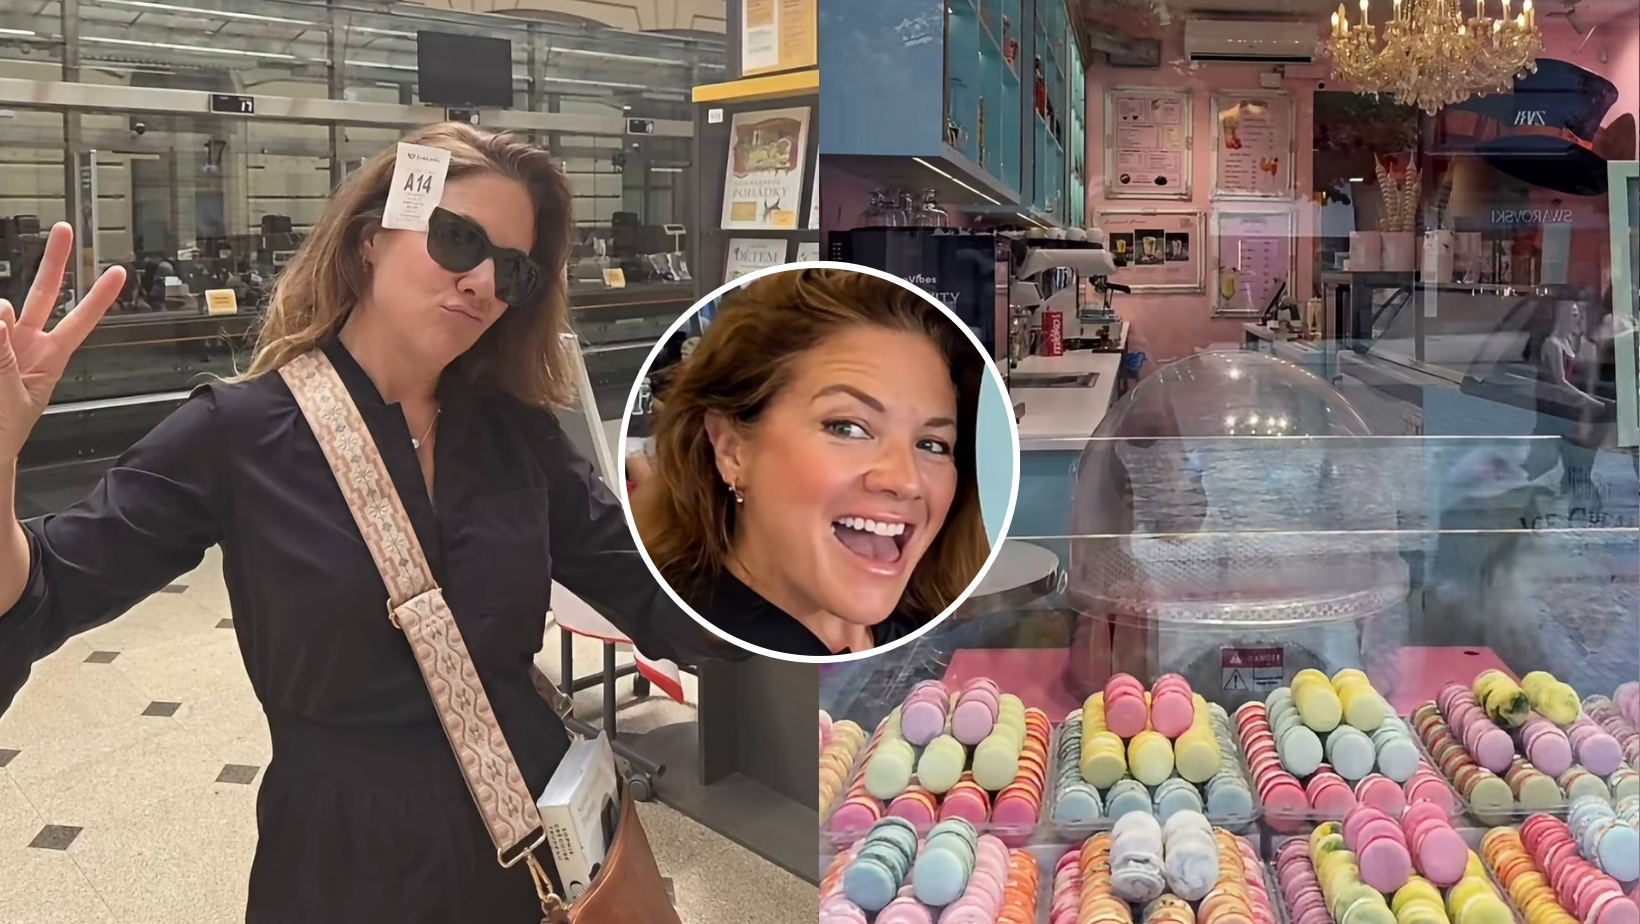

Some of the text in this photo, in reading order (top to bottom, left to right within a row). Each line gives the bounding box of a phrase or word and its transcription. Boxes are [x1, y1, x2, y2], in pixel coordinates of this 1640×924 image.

[241, 101, 253, 112] 17
[204, 139, 226, 166] 17
[403, 172, 433, 194] A14
[732, 185, 788, 199] POHÁDKY
[549, 826, 562, 861] TRUDEAU
[562, 827, 574, 855] SOPHIE
